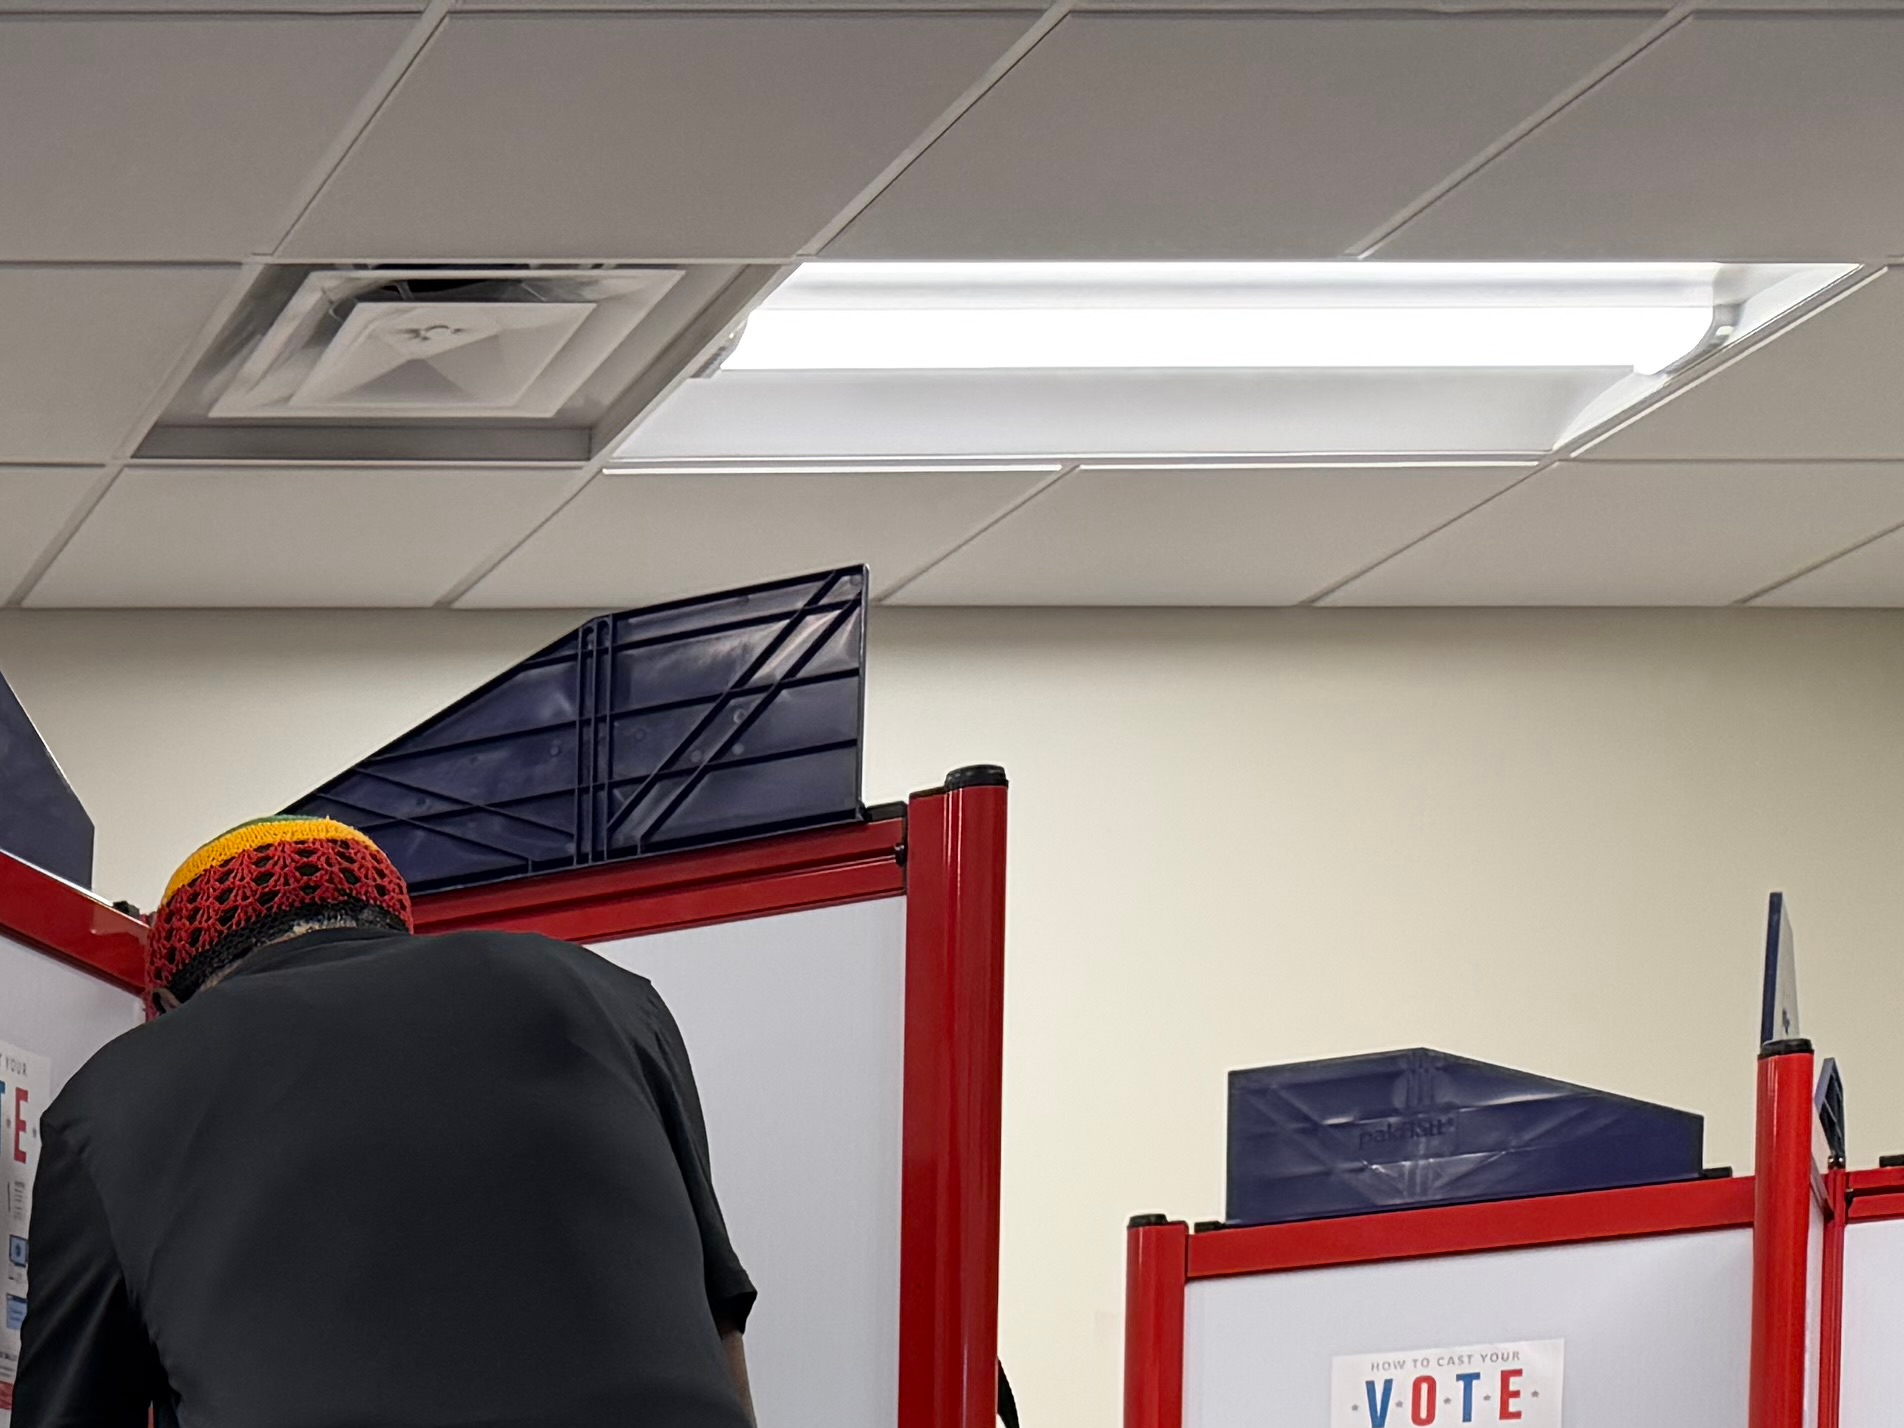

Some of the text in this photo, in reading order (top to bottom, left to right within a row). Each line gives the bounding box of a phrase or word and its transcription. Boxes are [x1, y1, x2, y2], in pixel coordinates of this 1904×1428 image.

[6, 1053, 27, 1076] YOUR
[1372, 1351, 1521, 1372] HOW TO CAST YOUR
